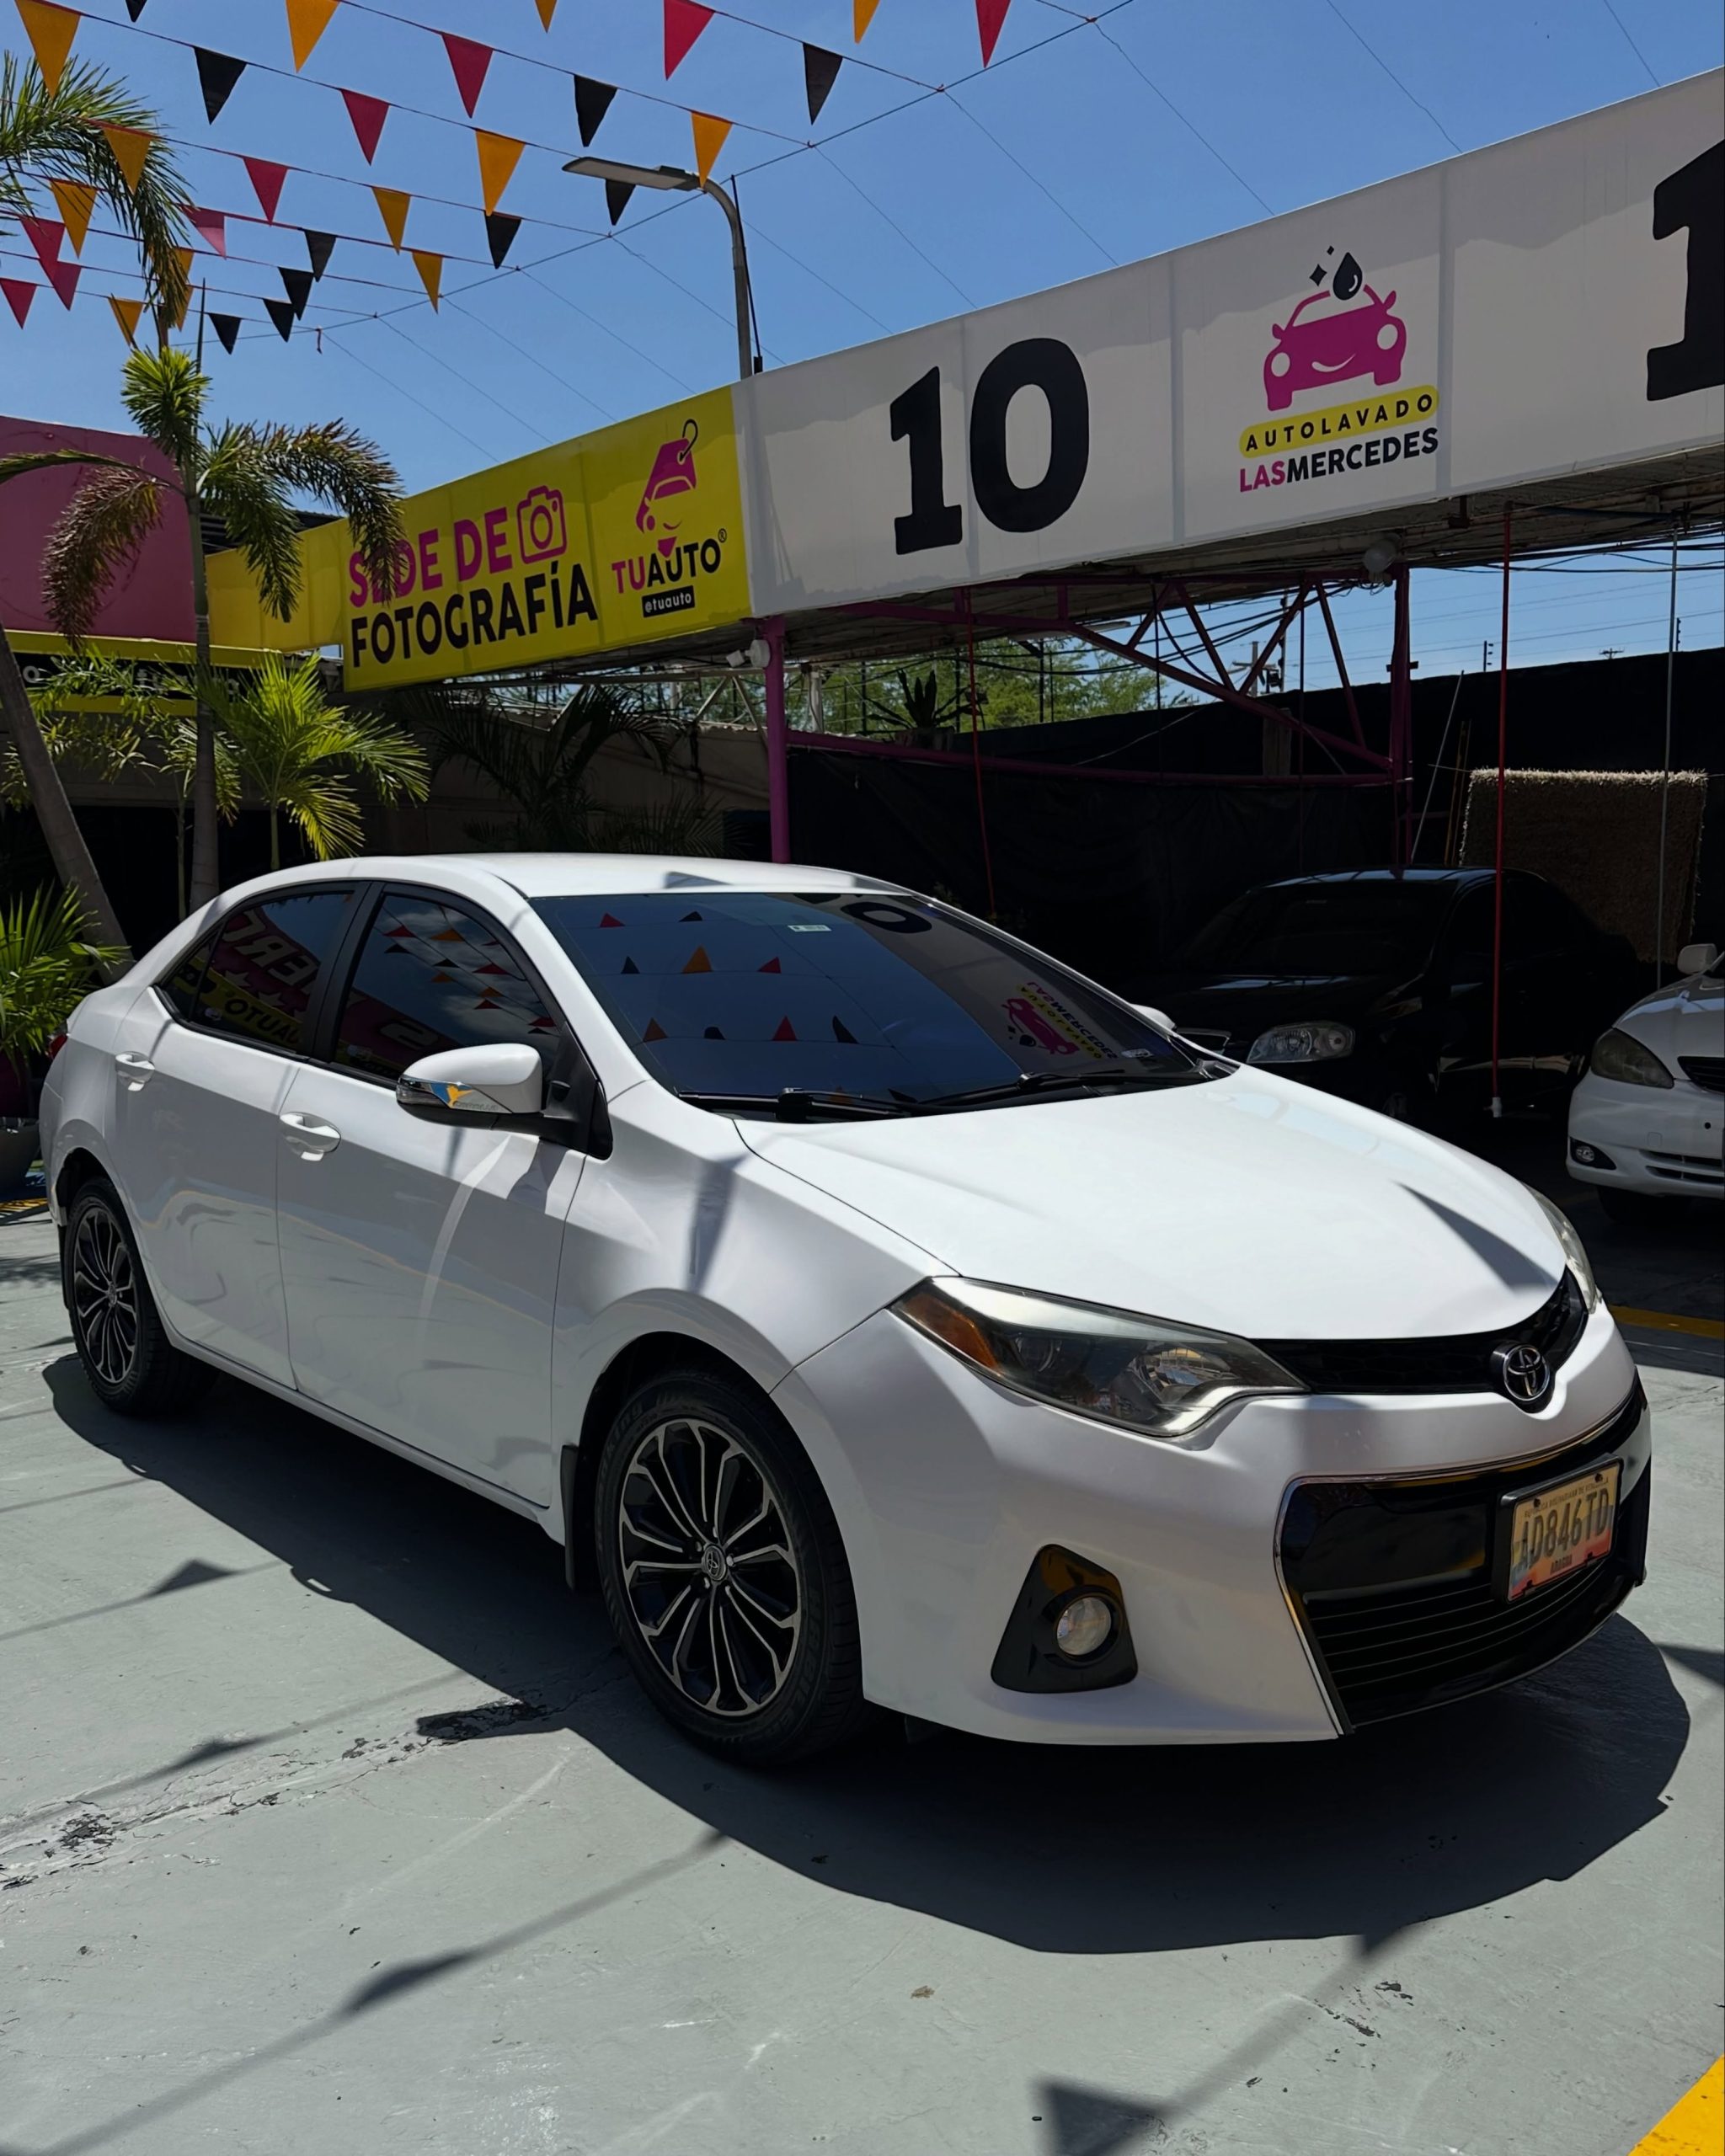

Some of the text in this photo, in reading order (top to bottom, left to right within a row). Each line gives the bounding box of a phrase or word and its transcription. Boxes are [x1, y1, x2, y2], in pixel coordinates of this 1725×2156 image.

[889, 337, 1090, 555] 10
[1246, 393, 1433, 451] AUTOLAVADO
[1239, 427, 1439, 493] LASMERCEDES
[453, 507, 514, 582] DE
[350, 560, 598, 668] FOTOGRAFÍA
[644, 592, 692, 613] @tuauto
[1521, 1487, 1610, 1570] AD846TD
